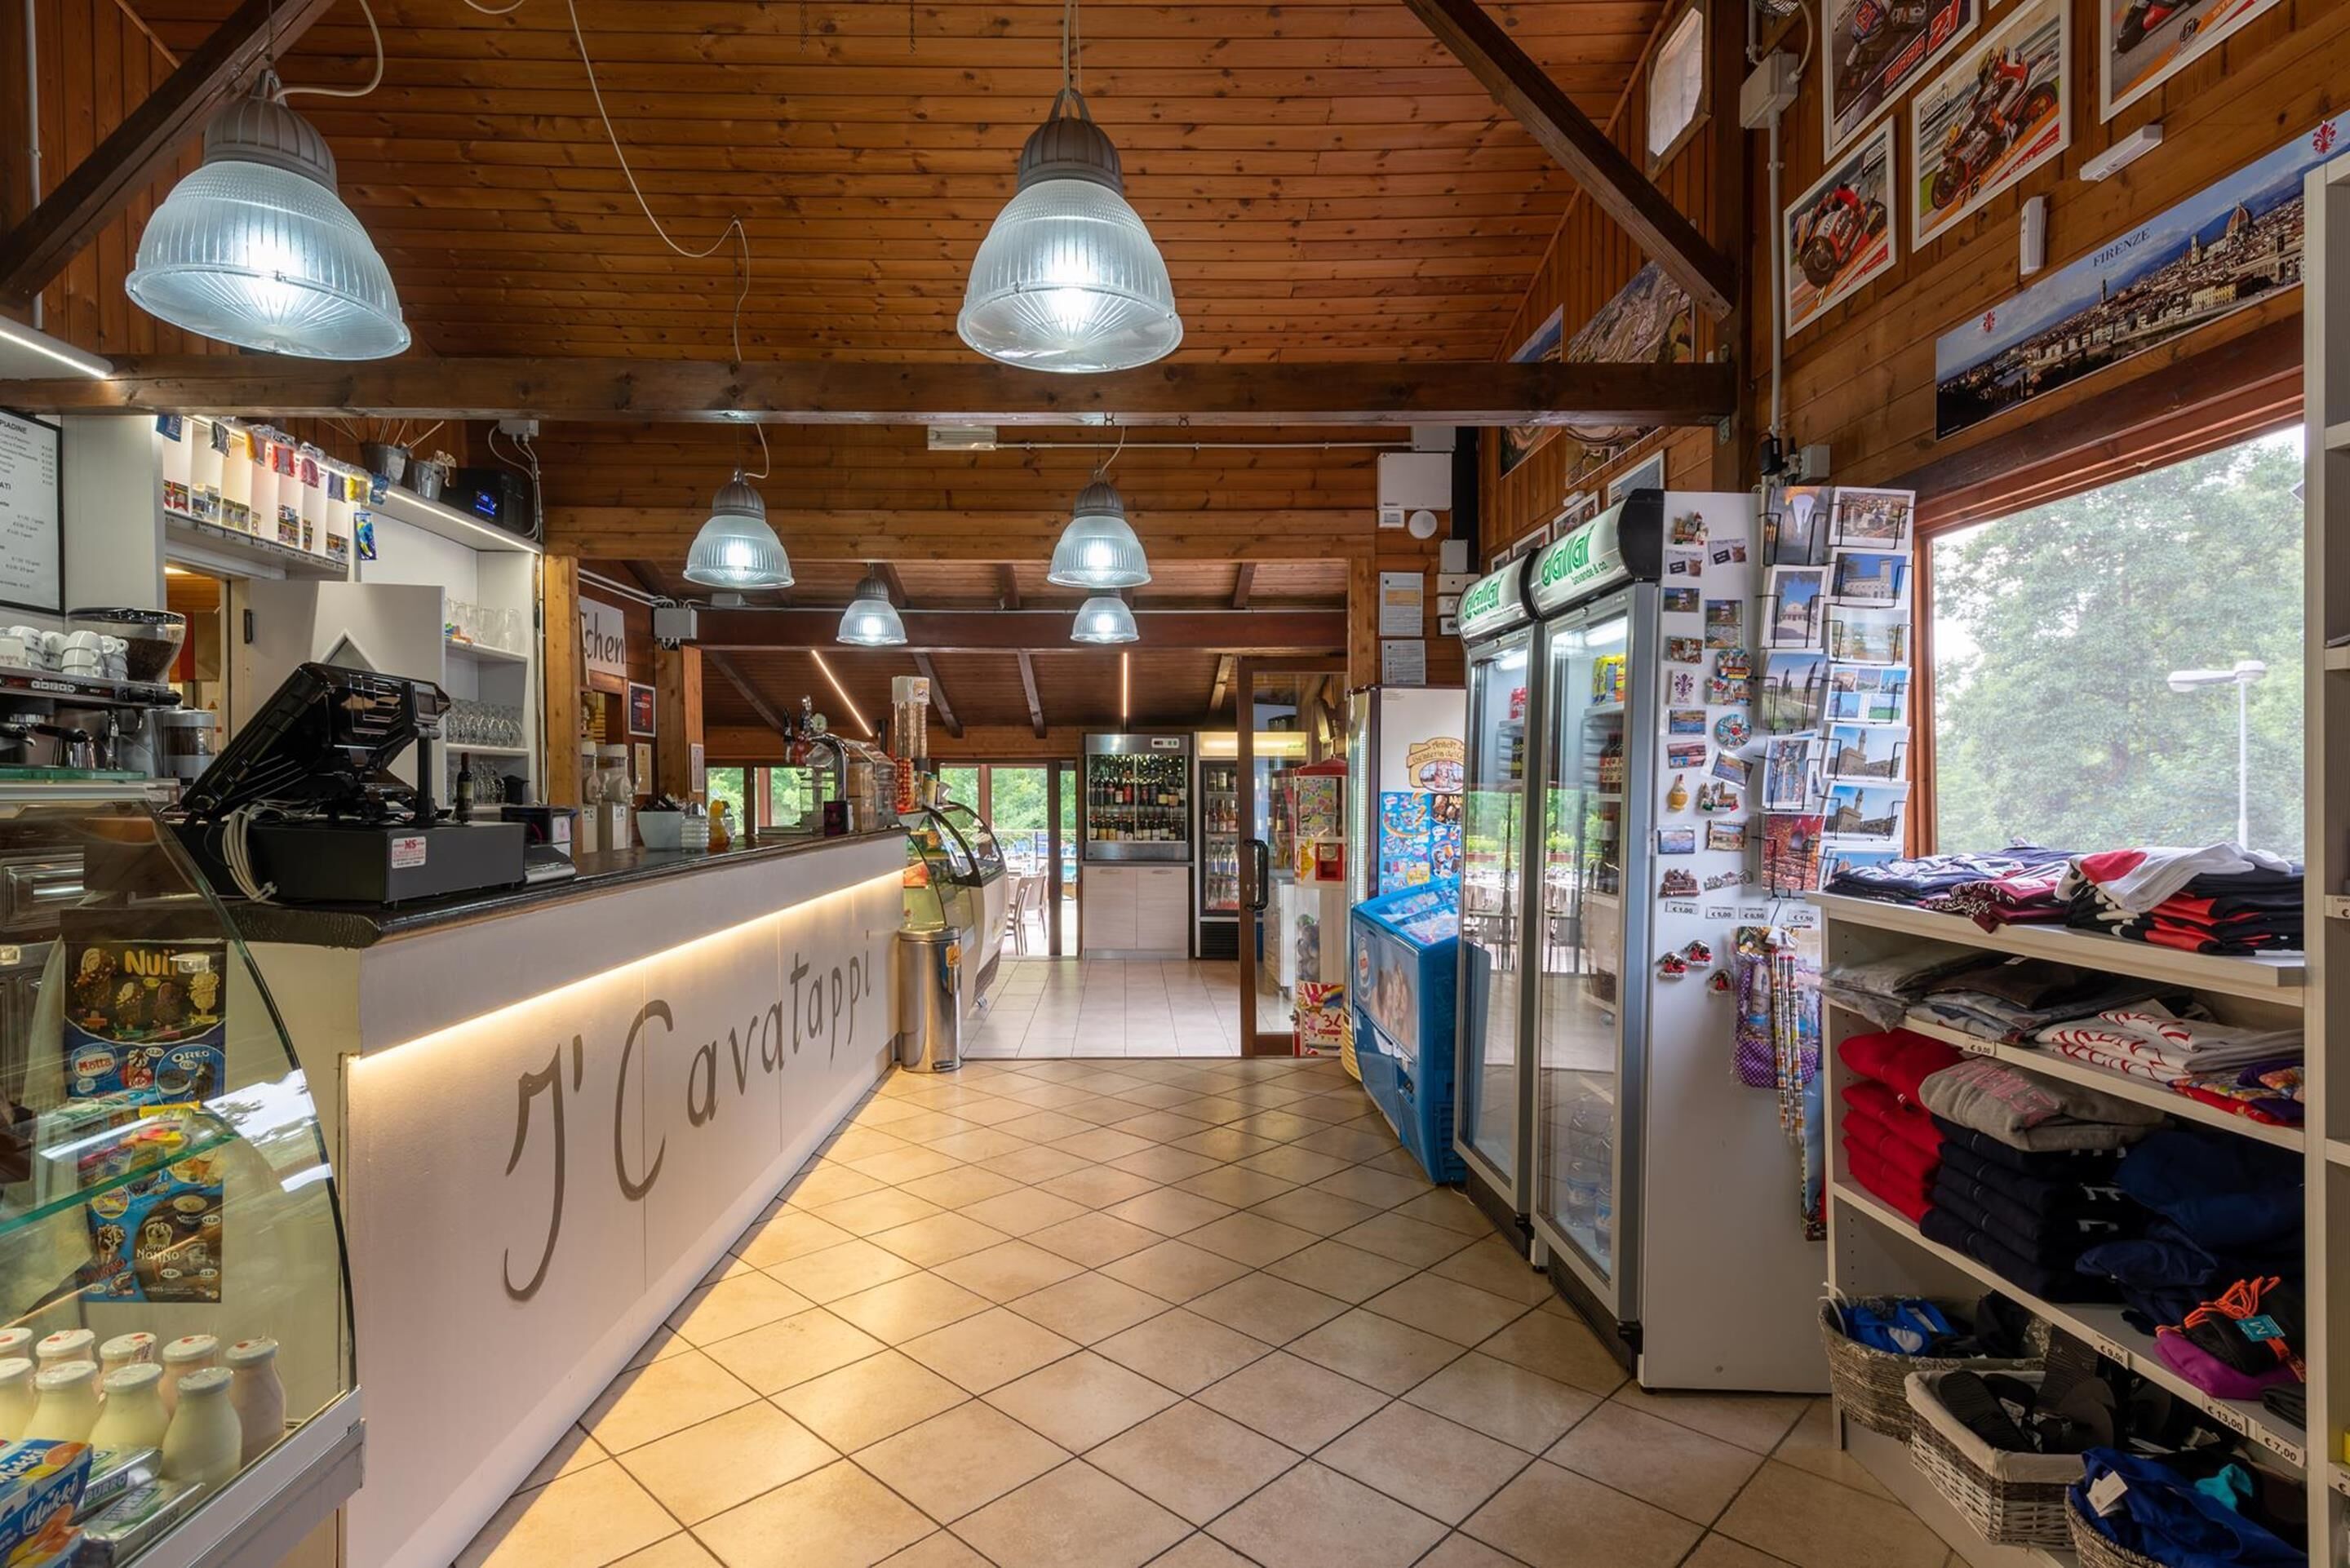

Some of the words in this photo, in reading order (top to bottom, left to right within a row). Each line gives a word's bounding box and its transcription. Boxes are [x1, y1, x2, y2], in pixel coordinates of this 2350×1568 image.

[2093, 228, 2150, 268] FIRENZE
[78, 1056, 114, 1073] Motta
[171, 1050, 210, 1063] OREO
[614, 930, 871, 1202] Cavatappi
[2207, 1404, 2215, 1415] €
[2216, 1410, 2243, 1432] 13,00
[2264, 1436, 2272, 1446] €
[2273, 1440, 2297, 1462] 7,00
[85, 1470, 127, 1501] BURRO
